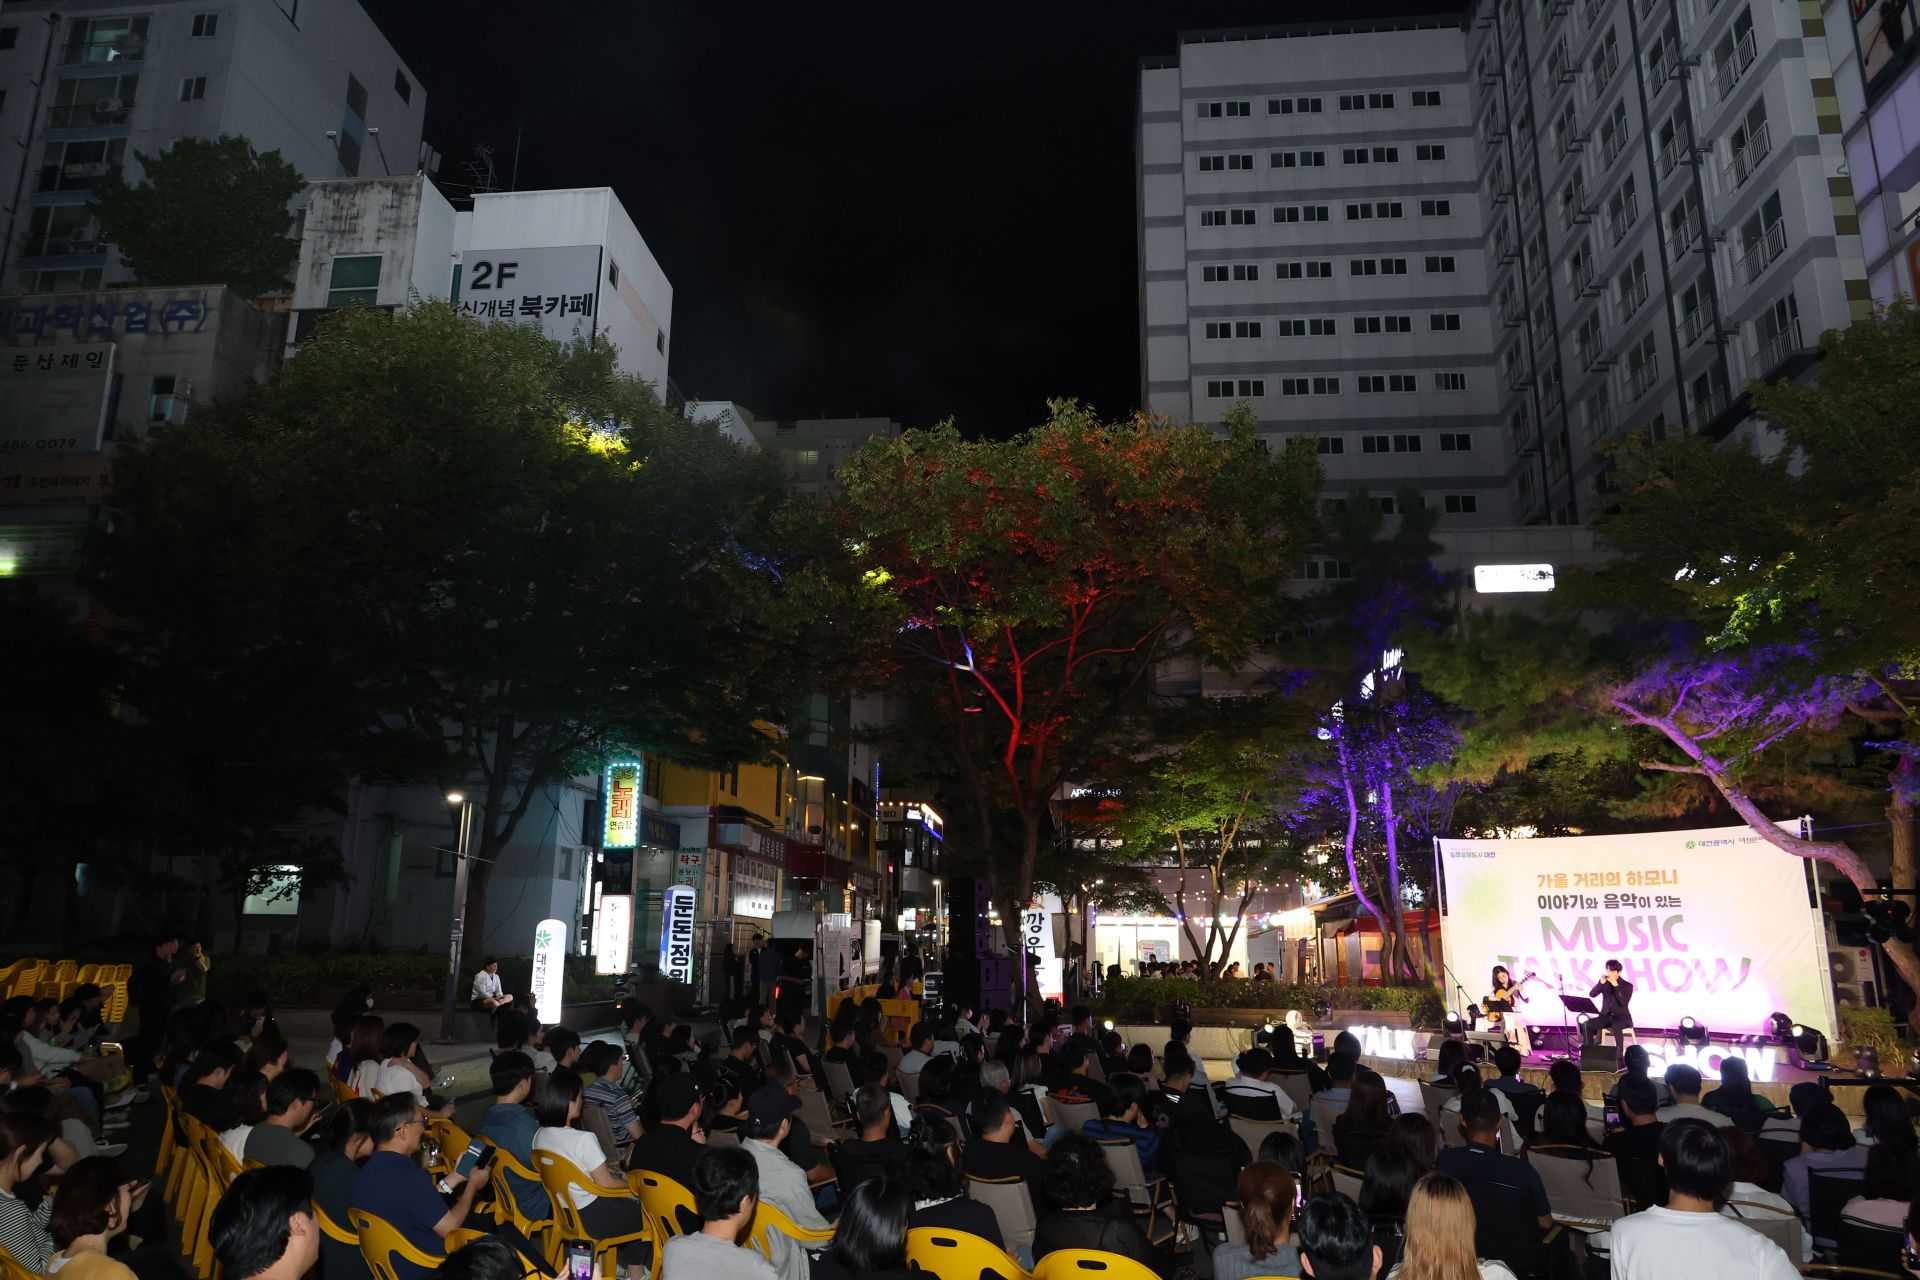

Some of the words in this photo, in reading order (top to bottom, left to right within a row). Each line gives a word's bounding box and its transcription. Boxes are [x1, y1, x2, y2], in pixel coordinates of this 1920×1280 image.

[471, 261, 519, 290] 2F
[519, 293, 593, 318] 북카페
[611, 780, 633, 819] 노래
[609, 820, 633, 831] 연습장
[1537, 873, 1568, 888] 가을
[1573, 871, 1621, 887] 거리의
[1626, 869, 1679, 886] 하모니
[1537, 894, 1598, 910] 이야기와
[1603, 893, 1651, 909] 음악이
[1655, 895, 1682, 908] 있는
[1540, 914, 1689, 952] MUSIC
[535, 953, 547, 1016] 대전광역
[1497, 954, 1597, 992] TALK
[1623, 956, 1752, 994] HOW
[1348, 1025, 1416, 1060] TALK
[1641, 1043, 1776, 1082] SHOW
